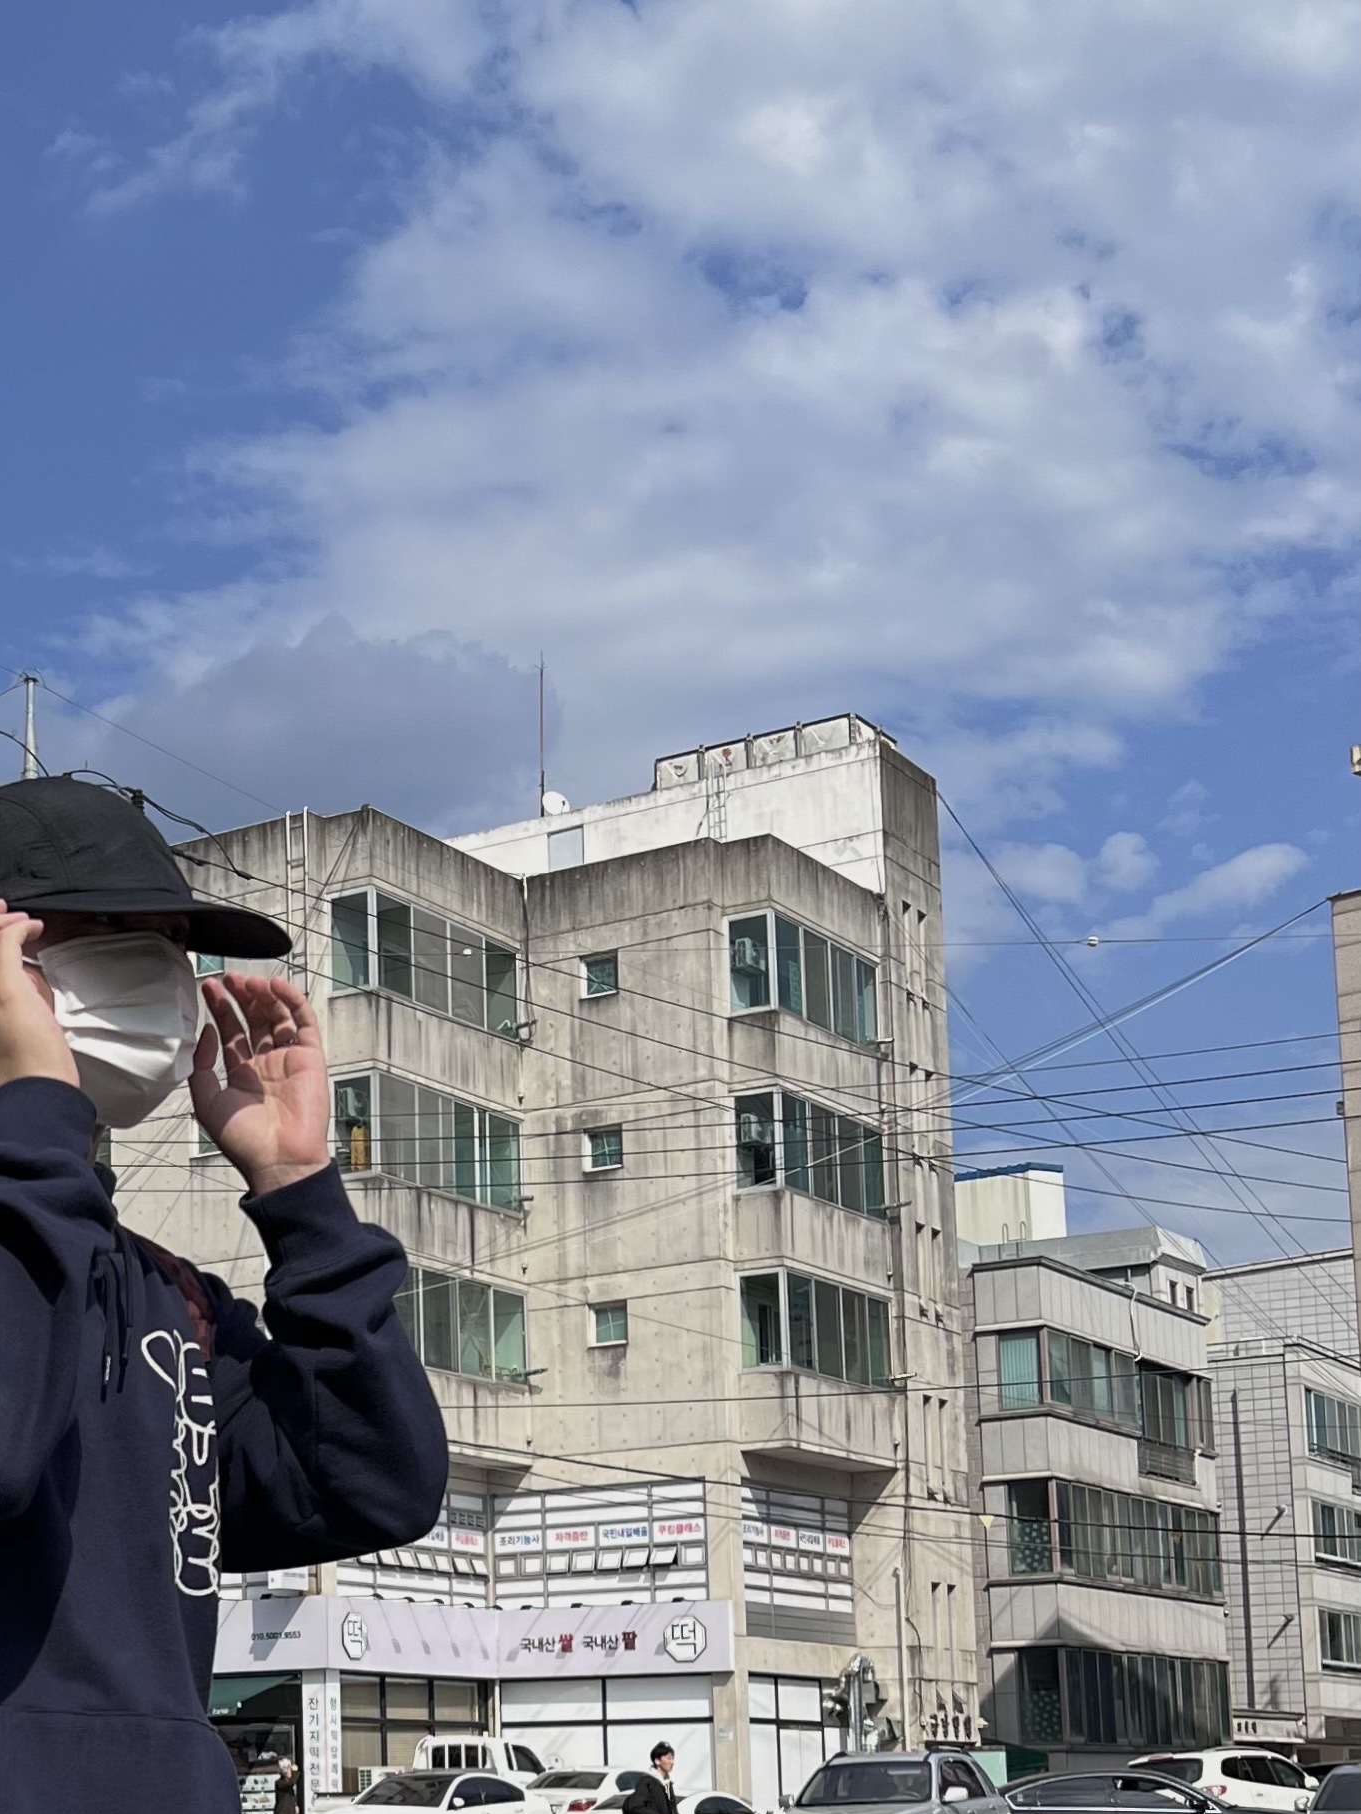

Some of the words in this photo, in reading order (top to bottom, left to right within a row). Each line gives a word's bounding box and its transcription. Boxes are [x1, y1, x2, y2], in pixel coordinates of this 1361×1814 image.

[499, 1535, 540, 1546] 조리기능사
[658, 1523, 702, 1536] 쿠킹클래스
[347, 1619, 363, 1654] 떡
[520, 1637, 556, 1653] 국내산
[559, 1633, 574, 1653] 쌀
[583, 1634, 619, 1650] 국내산
[671, 1621, 697, 1656] 떡
